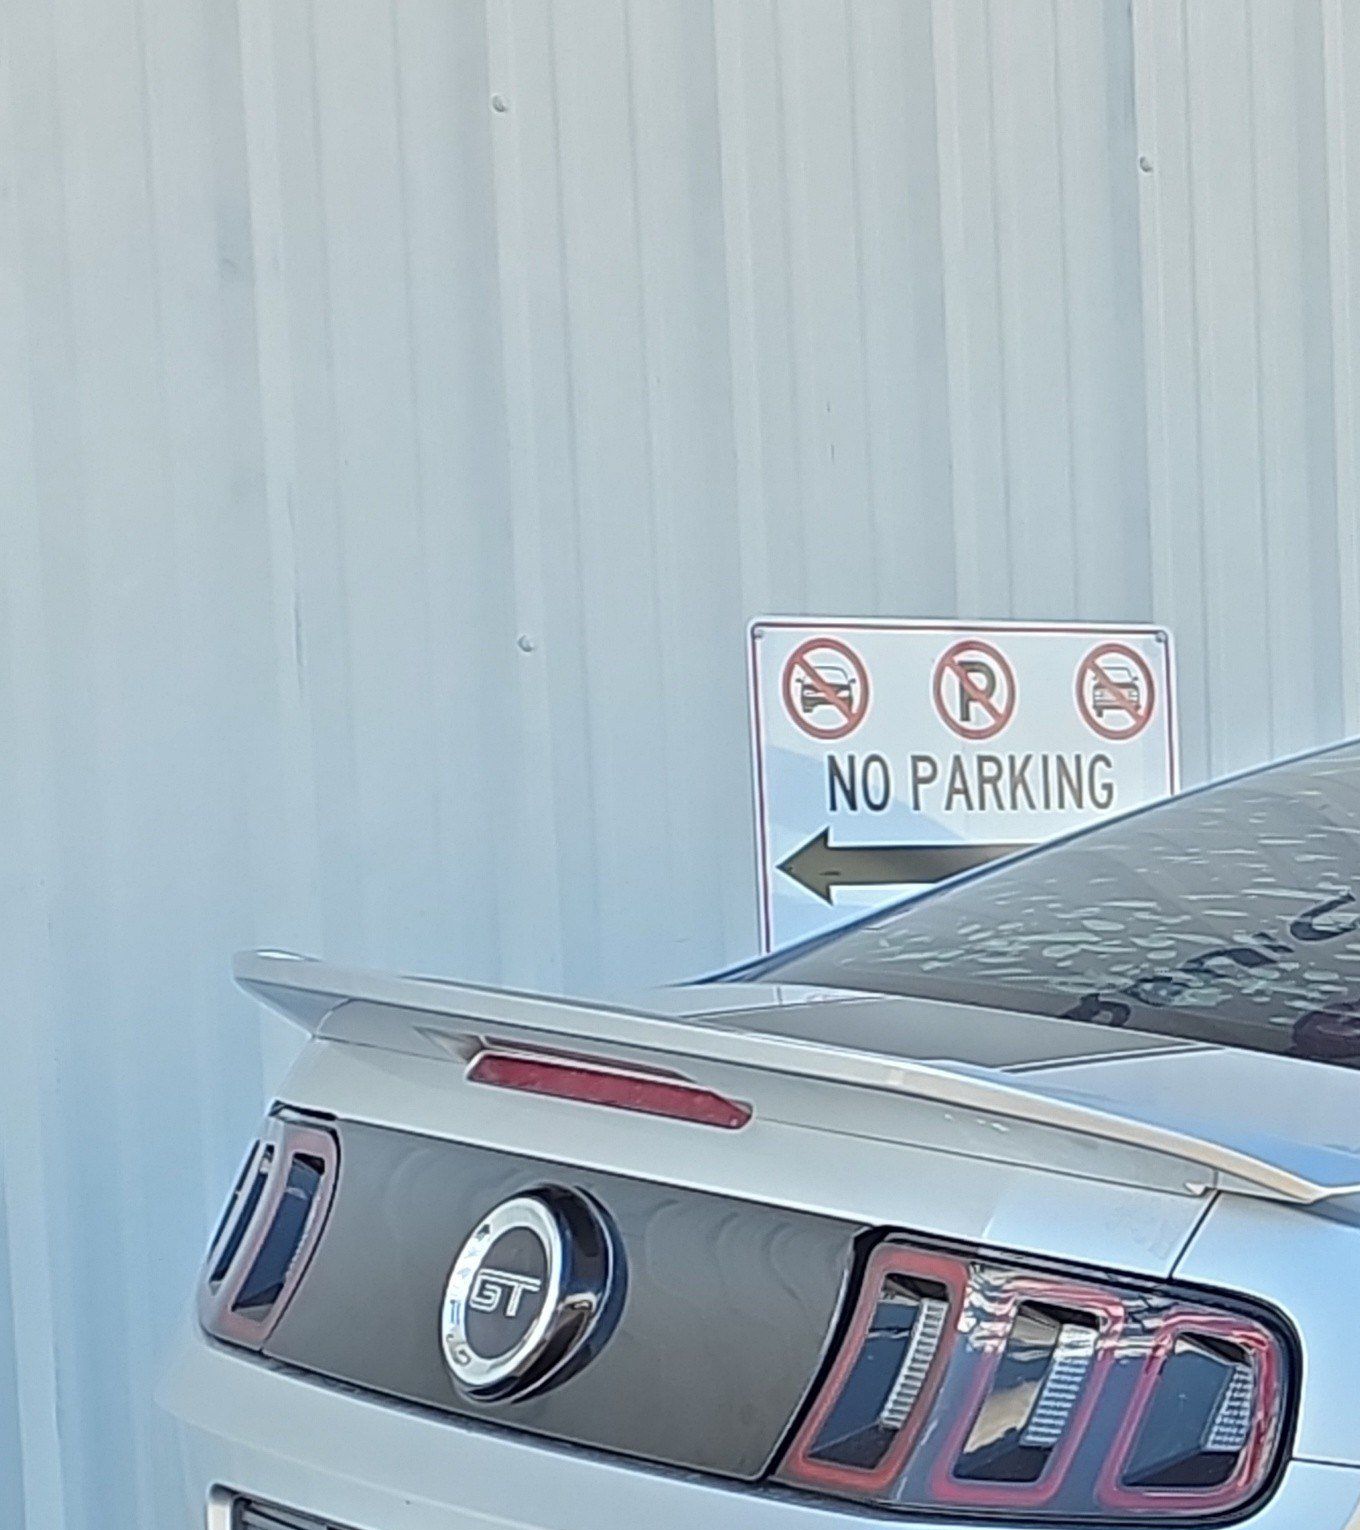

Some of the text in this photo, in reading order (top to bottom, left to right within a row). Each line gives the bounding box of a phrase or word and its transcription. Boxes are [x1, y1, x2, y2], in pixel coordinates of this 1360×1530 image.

[826, 754, 1115, 812] NO PARKING
[469, 1267, 541, 1318] GT
